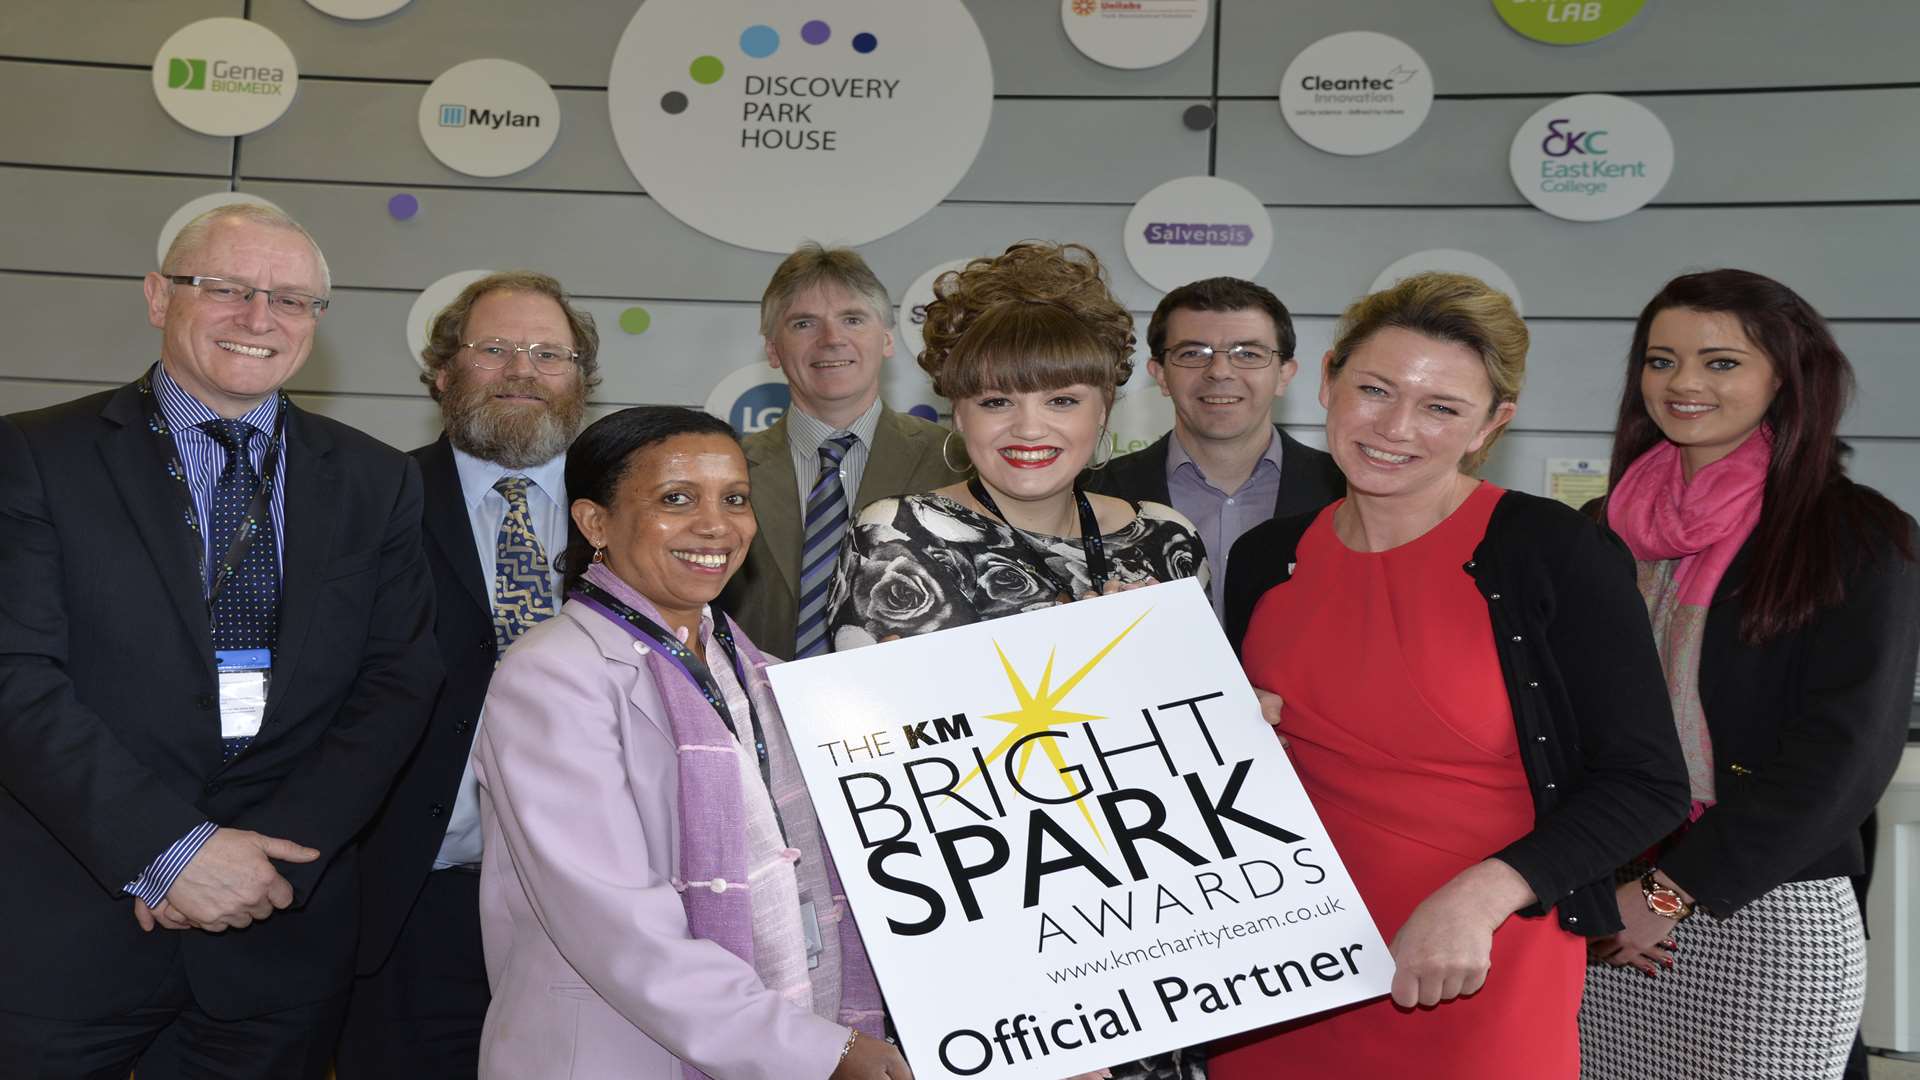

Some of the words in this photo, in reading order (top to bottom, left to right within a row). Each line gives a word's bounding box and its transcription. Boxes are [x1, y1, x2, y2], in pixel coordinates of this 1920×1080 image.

[1546, 2, 1602, 23] LAB
[213, 60, 284, 82] Genea
[212, 80, 282, 95] BIOMEDX
[745, 75, 900, 99] DISCOVERY
[1301, 75, 1393, 91] Cleantec
[1315, 92, 1394, 104] Innovation
[469, 108, 540, 130] Mylan
[743, 102, 812, 123] PARK
[741, 128, 837, 151] HOUSE
[1541, 179, 1608, 196] College
[1151, 225, 1246, 243] Salvensis
[817, 730, 896, 767] THE
[902, 712, 974, 750] KM
[838, 691, 1225, 850] BRIGHT
[866, 758, 1306, 937] SPARK
[1037, 848, 1326, 954] AWARDS
[1046, 895, 1346, 985] www.kmcharityteam.co.uk
[938, 988, 1143, 1077] Official
[1152, 942, 1364, 1024] Partner
